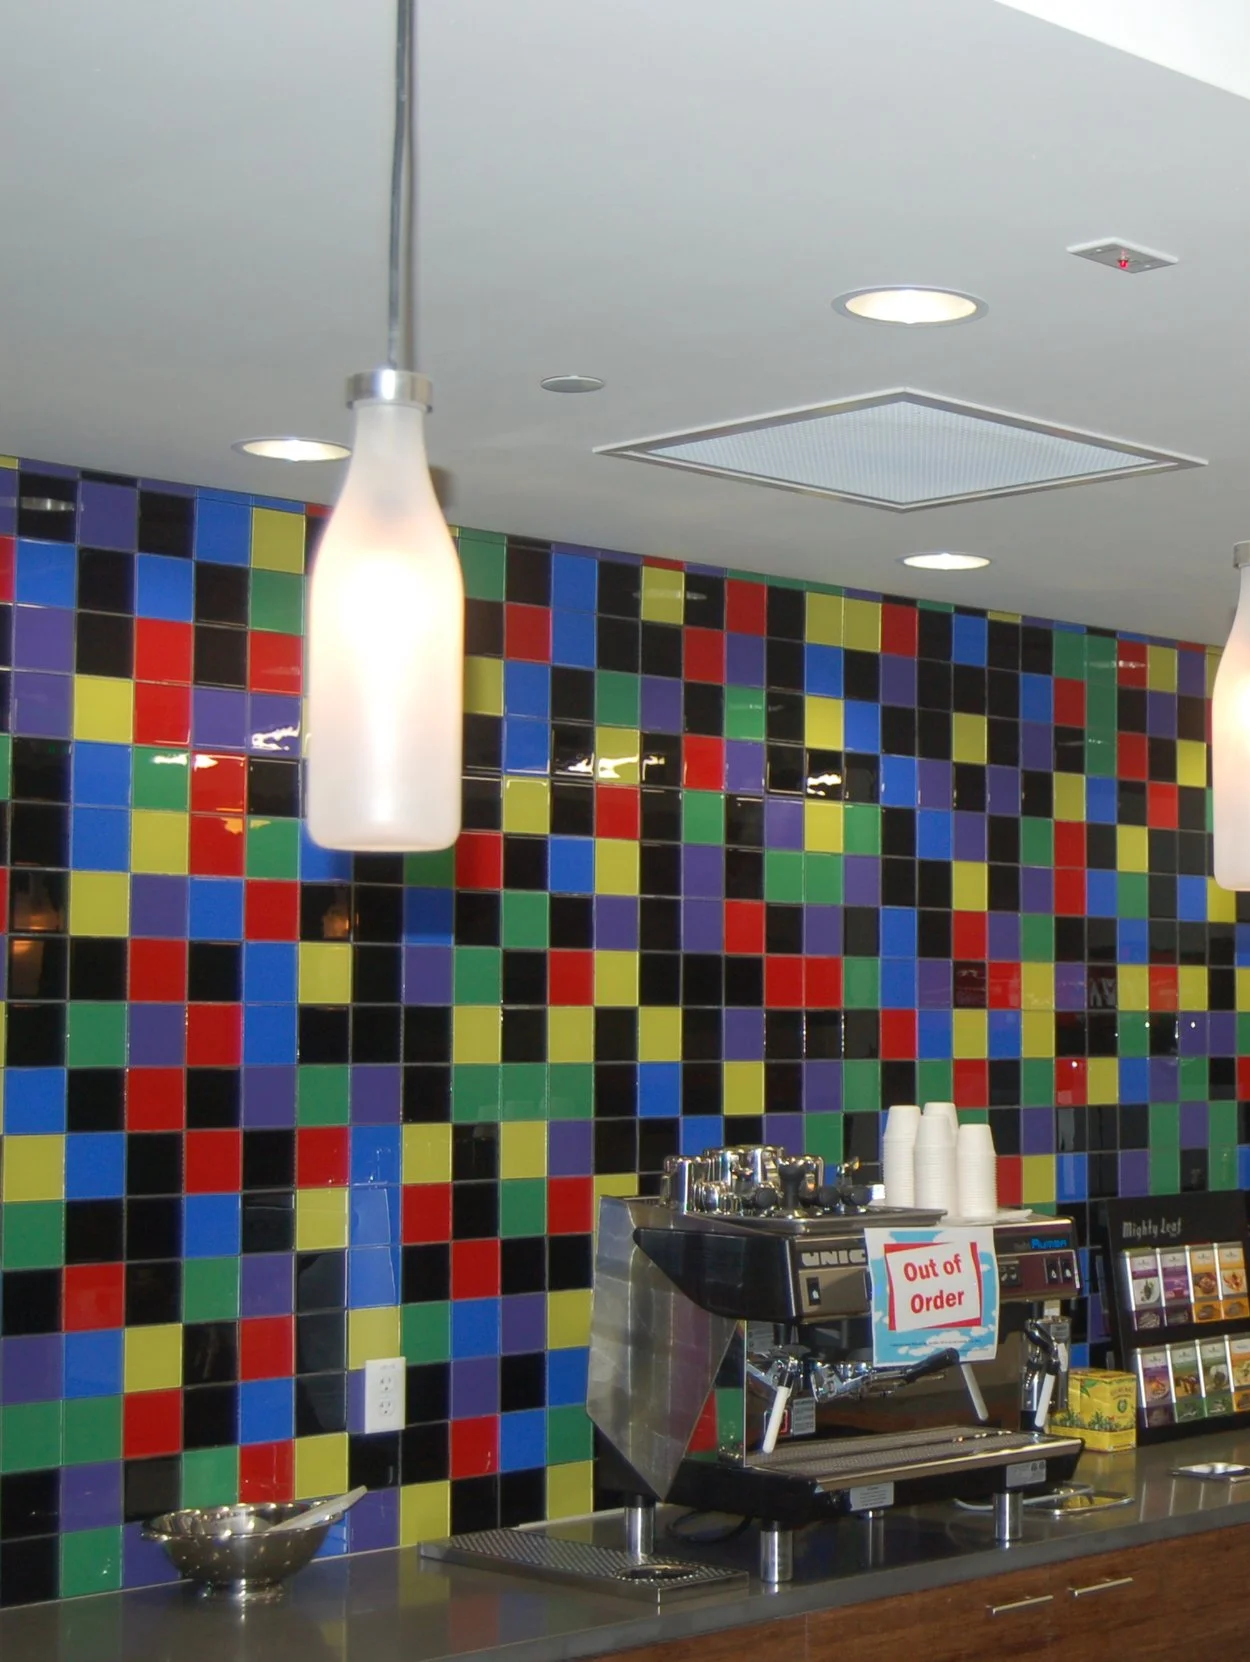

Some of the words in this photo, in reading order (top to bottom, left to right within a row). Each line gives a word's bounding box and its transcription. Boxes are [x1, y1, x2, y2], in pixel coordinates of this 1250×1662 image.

[1122, 1218, 1159, 1241] Mighty
[1160, 1217, 1182, 1236] Leaf
[903, 1258, 939, 1282] Out
[943, 1253, 962, 1275] of
[910, 1290, 965, 1314] Order
